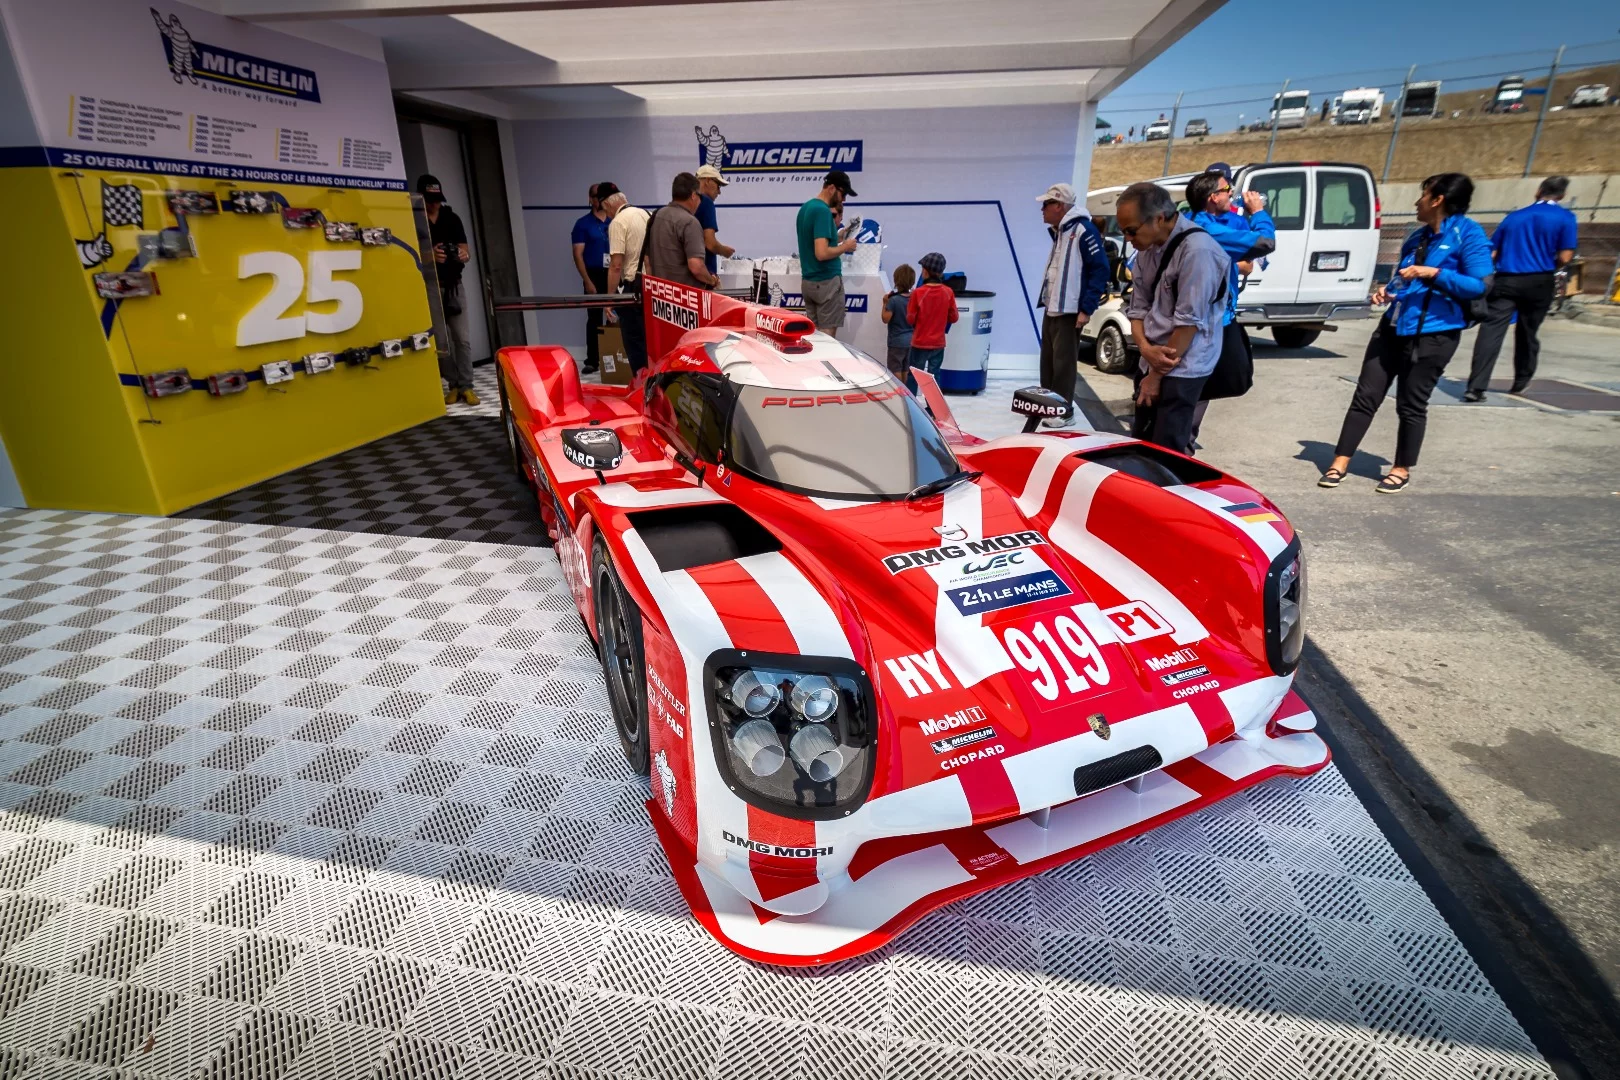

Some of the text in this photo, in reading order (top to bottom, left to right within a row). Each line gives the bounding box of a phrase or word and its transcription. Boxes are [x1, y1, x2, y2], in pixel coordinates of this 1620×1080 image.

[202, 51, 314, 92] MICHELIN
[201, 82, 298, 108] A better way forward
[730, 146, 858, 165] MICHELIN
[63, 153, 83, 165] 25
[85, 155, 151, 170] OVERALL
[153, 160, 189, 174] WINS
[190, 164, 206, 175] AT
[207, 166, 229, 177] THE
[231, 168, 244, 178] 24
[245, 170, 280, 182] HOURS
[281, 173, 294, 183] OF
[295, 174, 306, 184] LE
[307, 176, 333, 186] MANS
[334, 178, 346, 187] ON
[386, 182, 405, 191] TIRES
[735, 175, 765, 184] better
[768, 176, 788, 184] way
[236, 250, 364, 347] 25
[644, 278, 698, 310] PORSCHE
[701, 291, 712, 321] HY
[652, 297, 699, 331] DMG MORI
[756, 313, 775, 333] Mobil
[1013, 399, 1066, 415] CHOPARD
[883, 545, 966, 573] DMG
[962, 551, 1024, 574] WEC
[959, 579, 1058, 607] 24h LE MANS
[1106, 606, 1161, 637] P1
[1003, 614, 1111, 701] 919
[1145, 650, 1185, 672] Mobil
[884, 649, 952, 699] HY
[1175, 666, 1208, 681] MICHELIN
[1172, 679, 1220, 700] CHOPARD
[666, 711, 684, 740] FAG
[919, 712, 970, 736] Mobil
[951, 728, 995, 747] MICHELIN
[940, 744, 1005, 771] CHOPARD
[722, 829, 834, 858] DMG MORI
